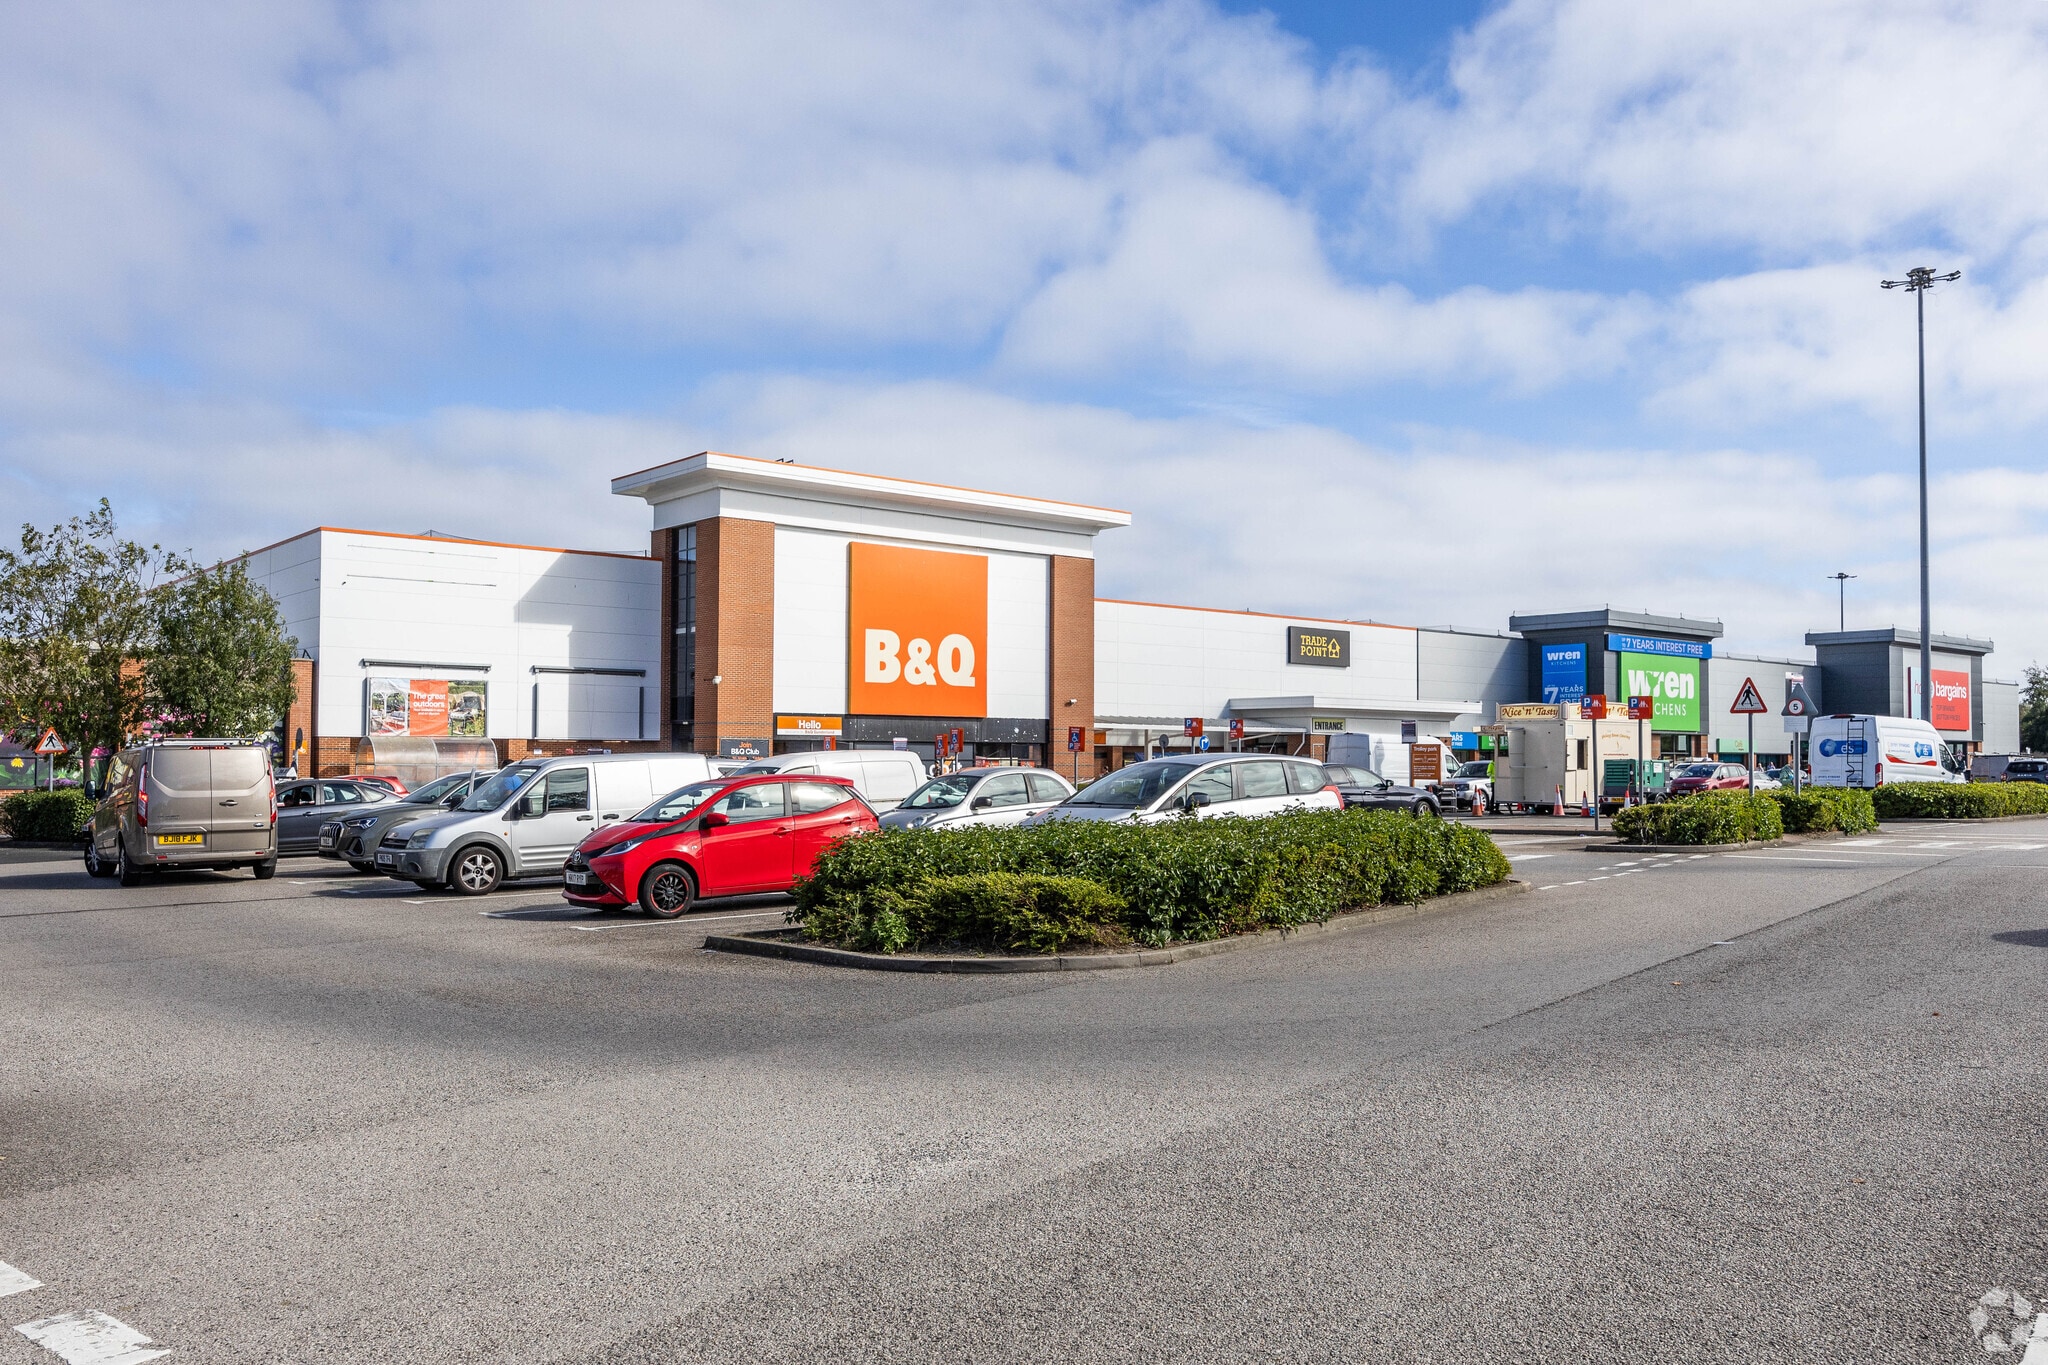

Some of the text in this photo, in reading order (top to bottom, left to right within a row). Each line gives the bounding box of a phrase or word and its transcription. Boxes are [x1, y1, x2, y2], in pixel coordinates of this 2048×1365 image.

[1300, 635, 1327, 646] TRADE
[1300, 646, 1327, 657] POINT
[1626, 638, 1631, 648] 7
[1631, 638, 1654, 650] YEARS
[1655, 640, 1686, 653] INTEREST
[1687, 644, 1703, 655] FREE
[864, 628, 976, 687] B&Q
[1547, 651, 1580, 660] wren
[1628, 669, 1694, 699] wren
[1544, 687, 1559, 704] 7
[1936, 680, 1966, 701] bargains
[427, 693, 446, 701] great
[1583, 697, 1591, 707] P
[1630, 698, 1638, 707] P
[1502, 707, 1521, 718] Nice
[1535, 707, 1558, 719] Tasty
[1654, 702, 1687, 716] CHENS
[798, 719, 822, 729] Hello
[1314, 721, 1343, 731] ENTRANCE
